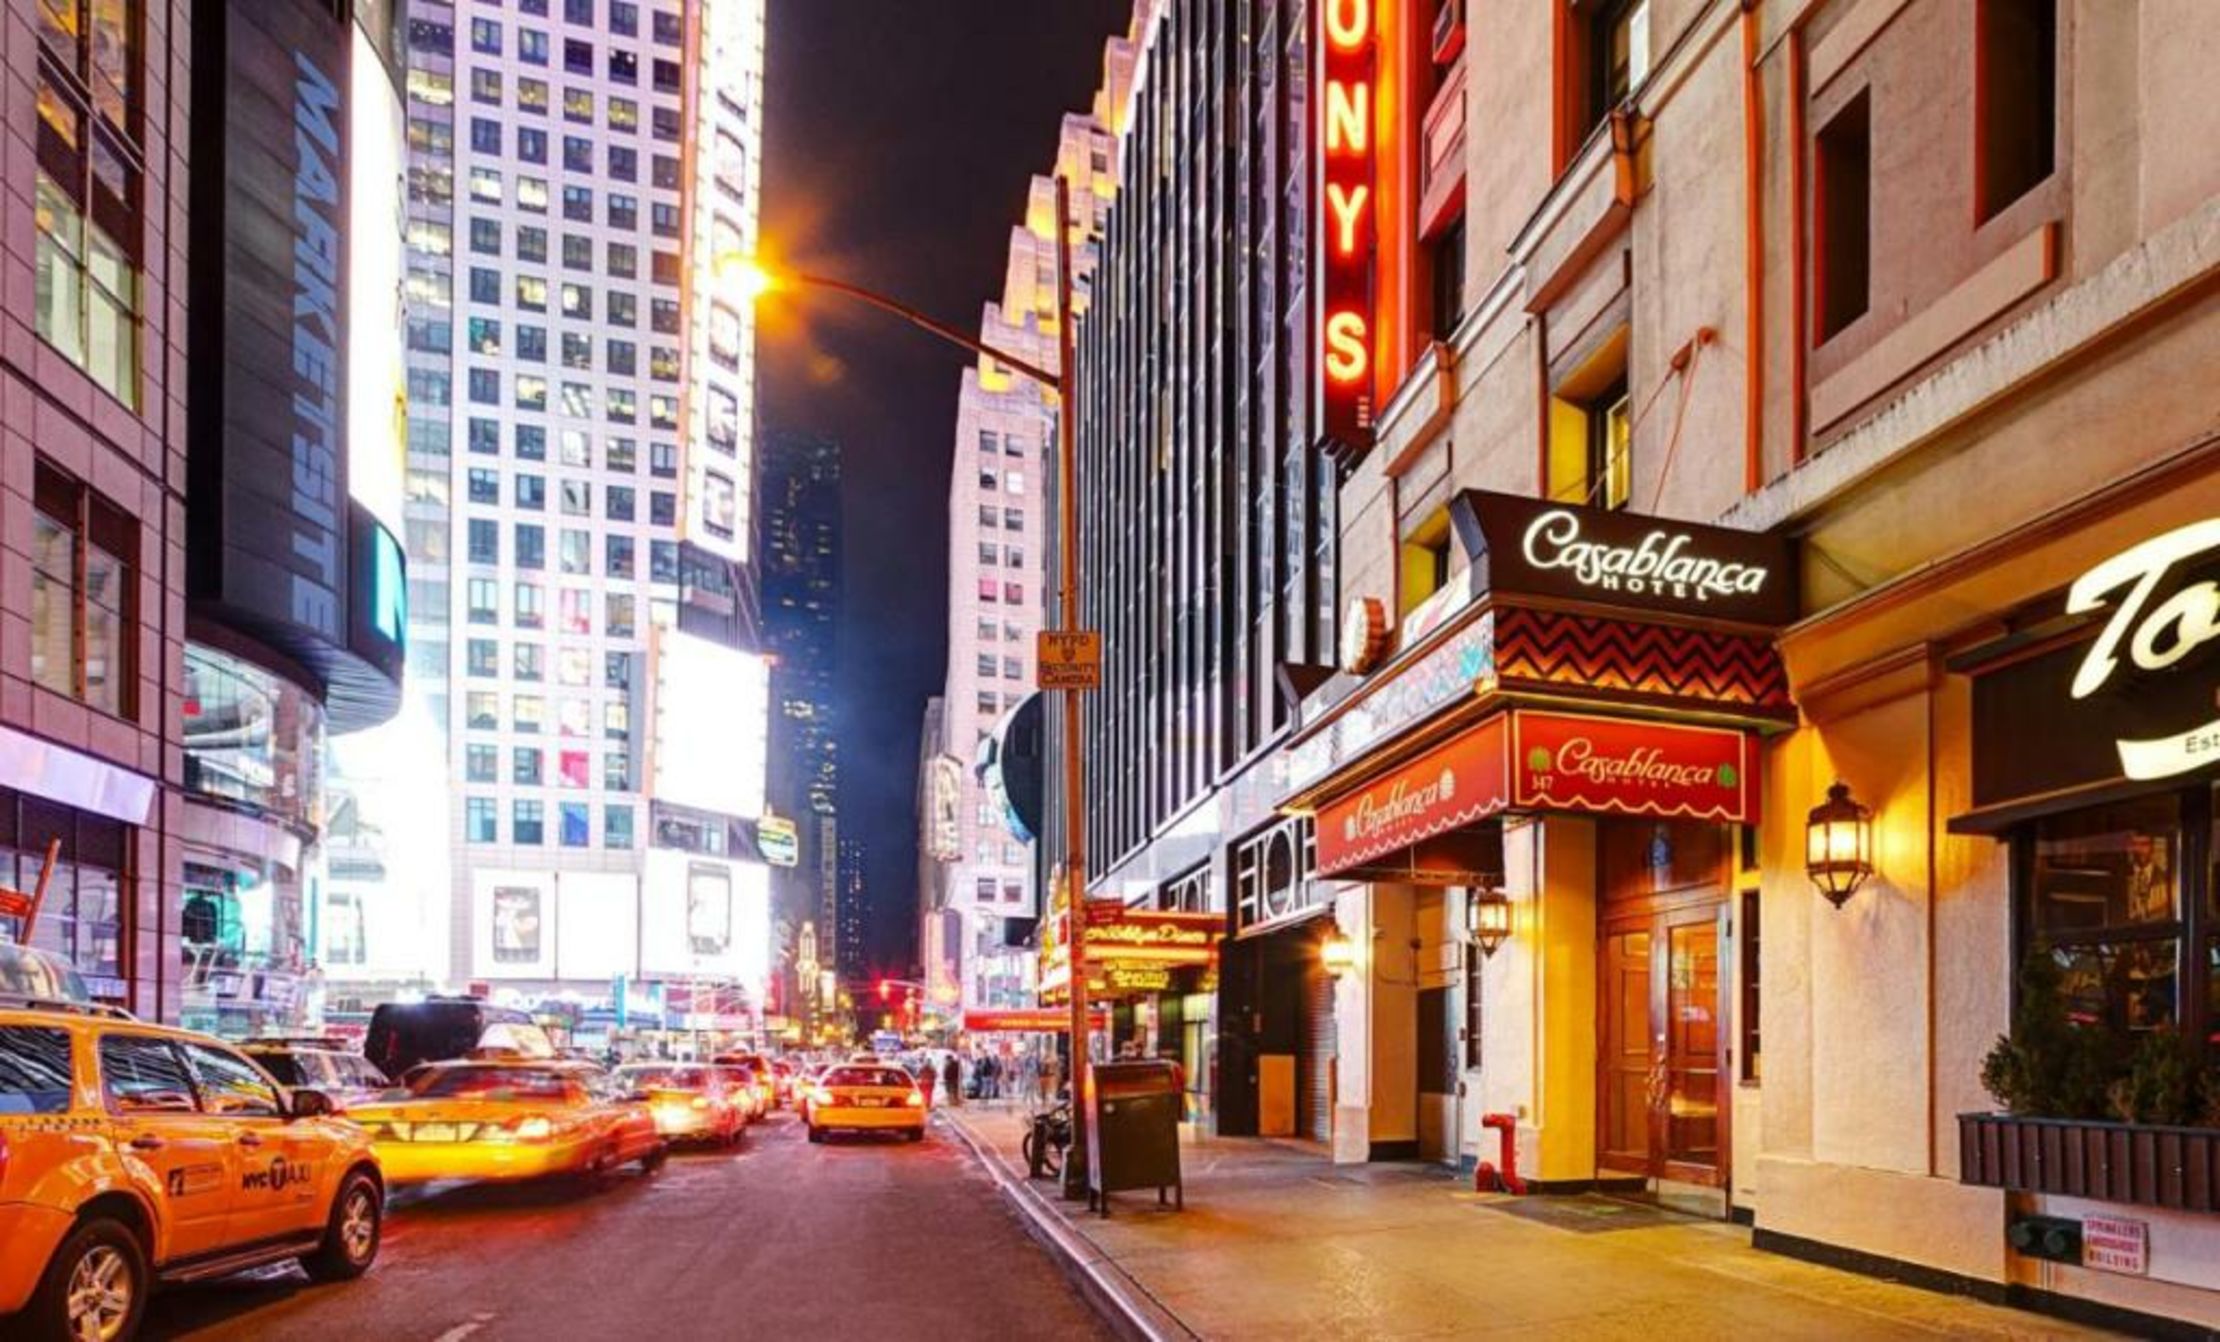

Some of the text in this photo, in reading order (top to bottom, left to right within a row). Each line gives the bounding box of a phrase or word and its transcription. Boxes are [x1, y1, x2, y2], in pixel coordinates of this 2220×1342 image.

[292, 50, 340, 642] MARKETSITE
[1522, 510, 1768, 594] Casablanca
[1601, 574, 1708, 601] HOTEL
[1048, 634, 1088, 647] NYPD
[1040, 672, 1094, 684] CAMERA
[1556, 737, 1714, 786] Casablanca
[1357, 780, 1438, 838] Casablanca
